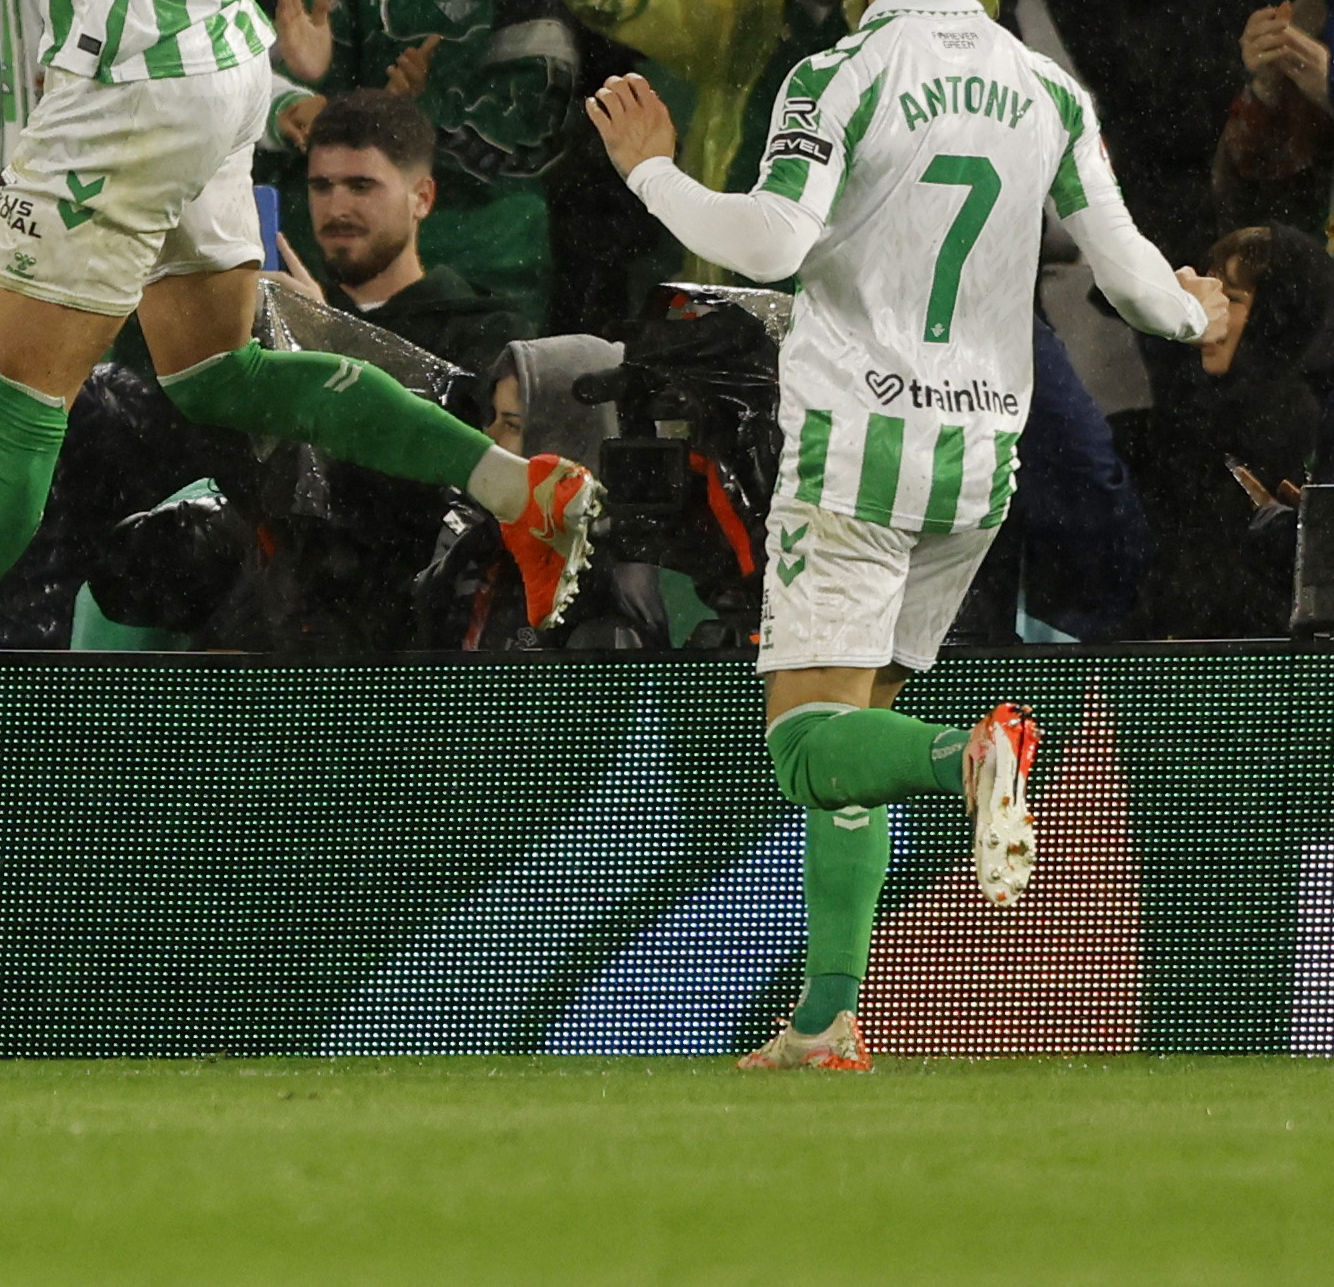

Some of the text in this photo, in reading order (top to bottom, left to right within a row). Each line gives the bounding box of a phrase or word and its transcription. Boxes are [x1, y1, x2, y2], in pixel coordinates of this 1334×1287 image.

[783, 97, 818, 130] R
[898, 76, 1033, 132] ANTONY
[770, 138, 828, 160] EVEL
[919, 154, 1002, 343] 7
[909, 380, 1019, 417] trainline
